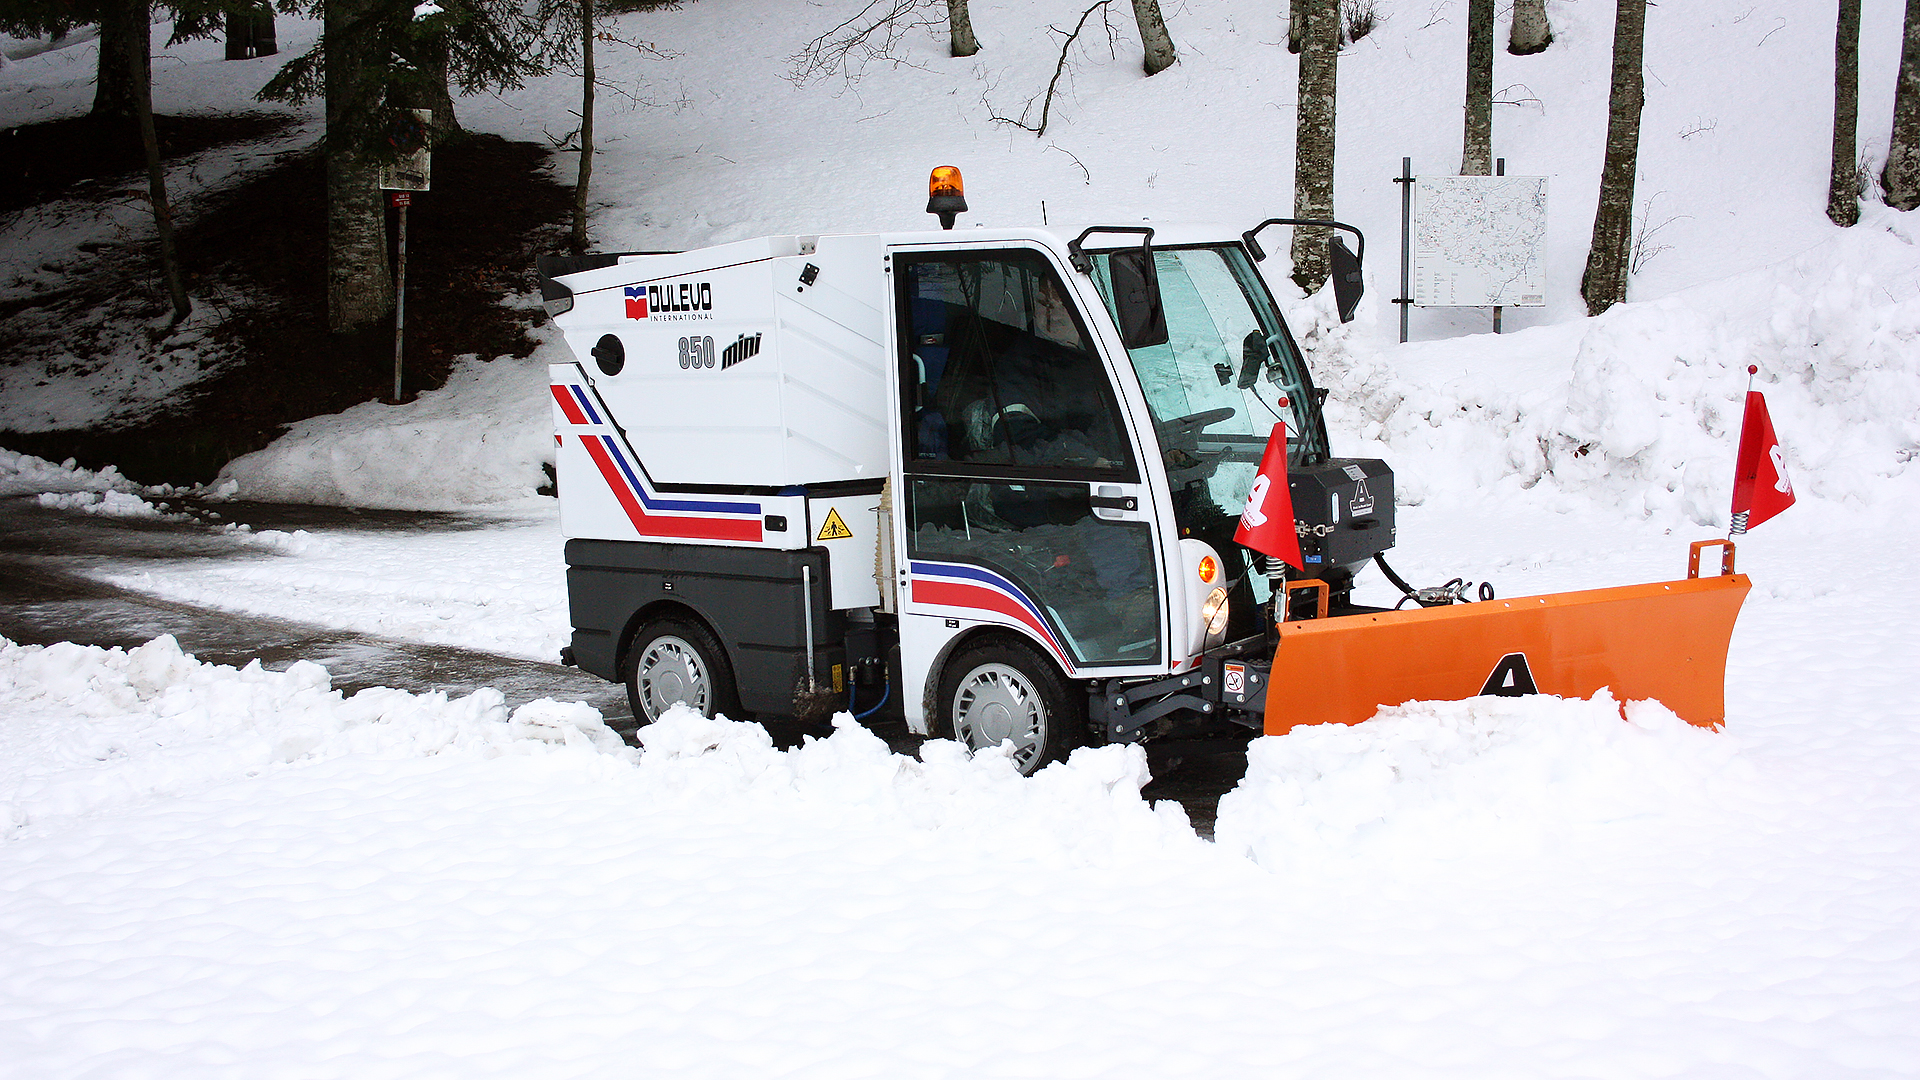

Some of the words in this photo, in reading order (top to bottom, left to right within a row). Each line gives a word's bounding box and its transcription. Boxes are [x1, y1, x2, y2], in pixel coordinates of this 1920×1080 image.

[649, 283, 712, 313] DULEVO
[650, 313, 713, 322] INTERNATIONAL
[678, 335, 715, 369] 850
[721, 332, 762, 371] mini
